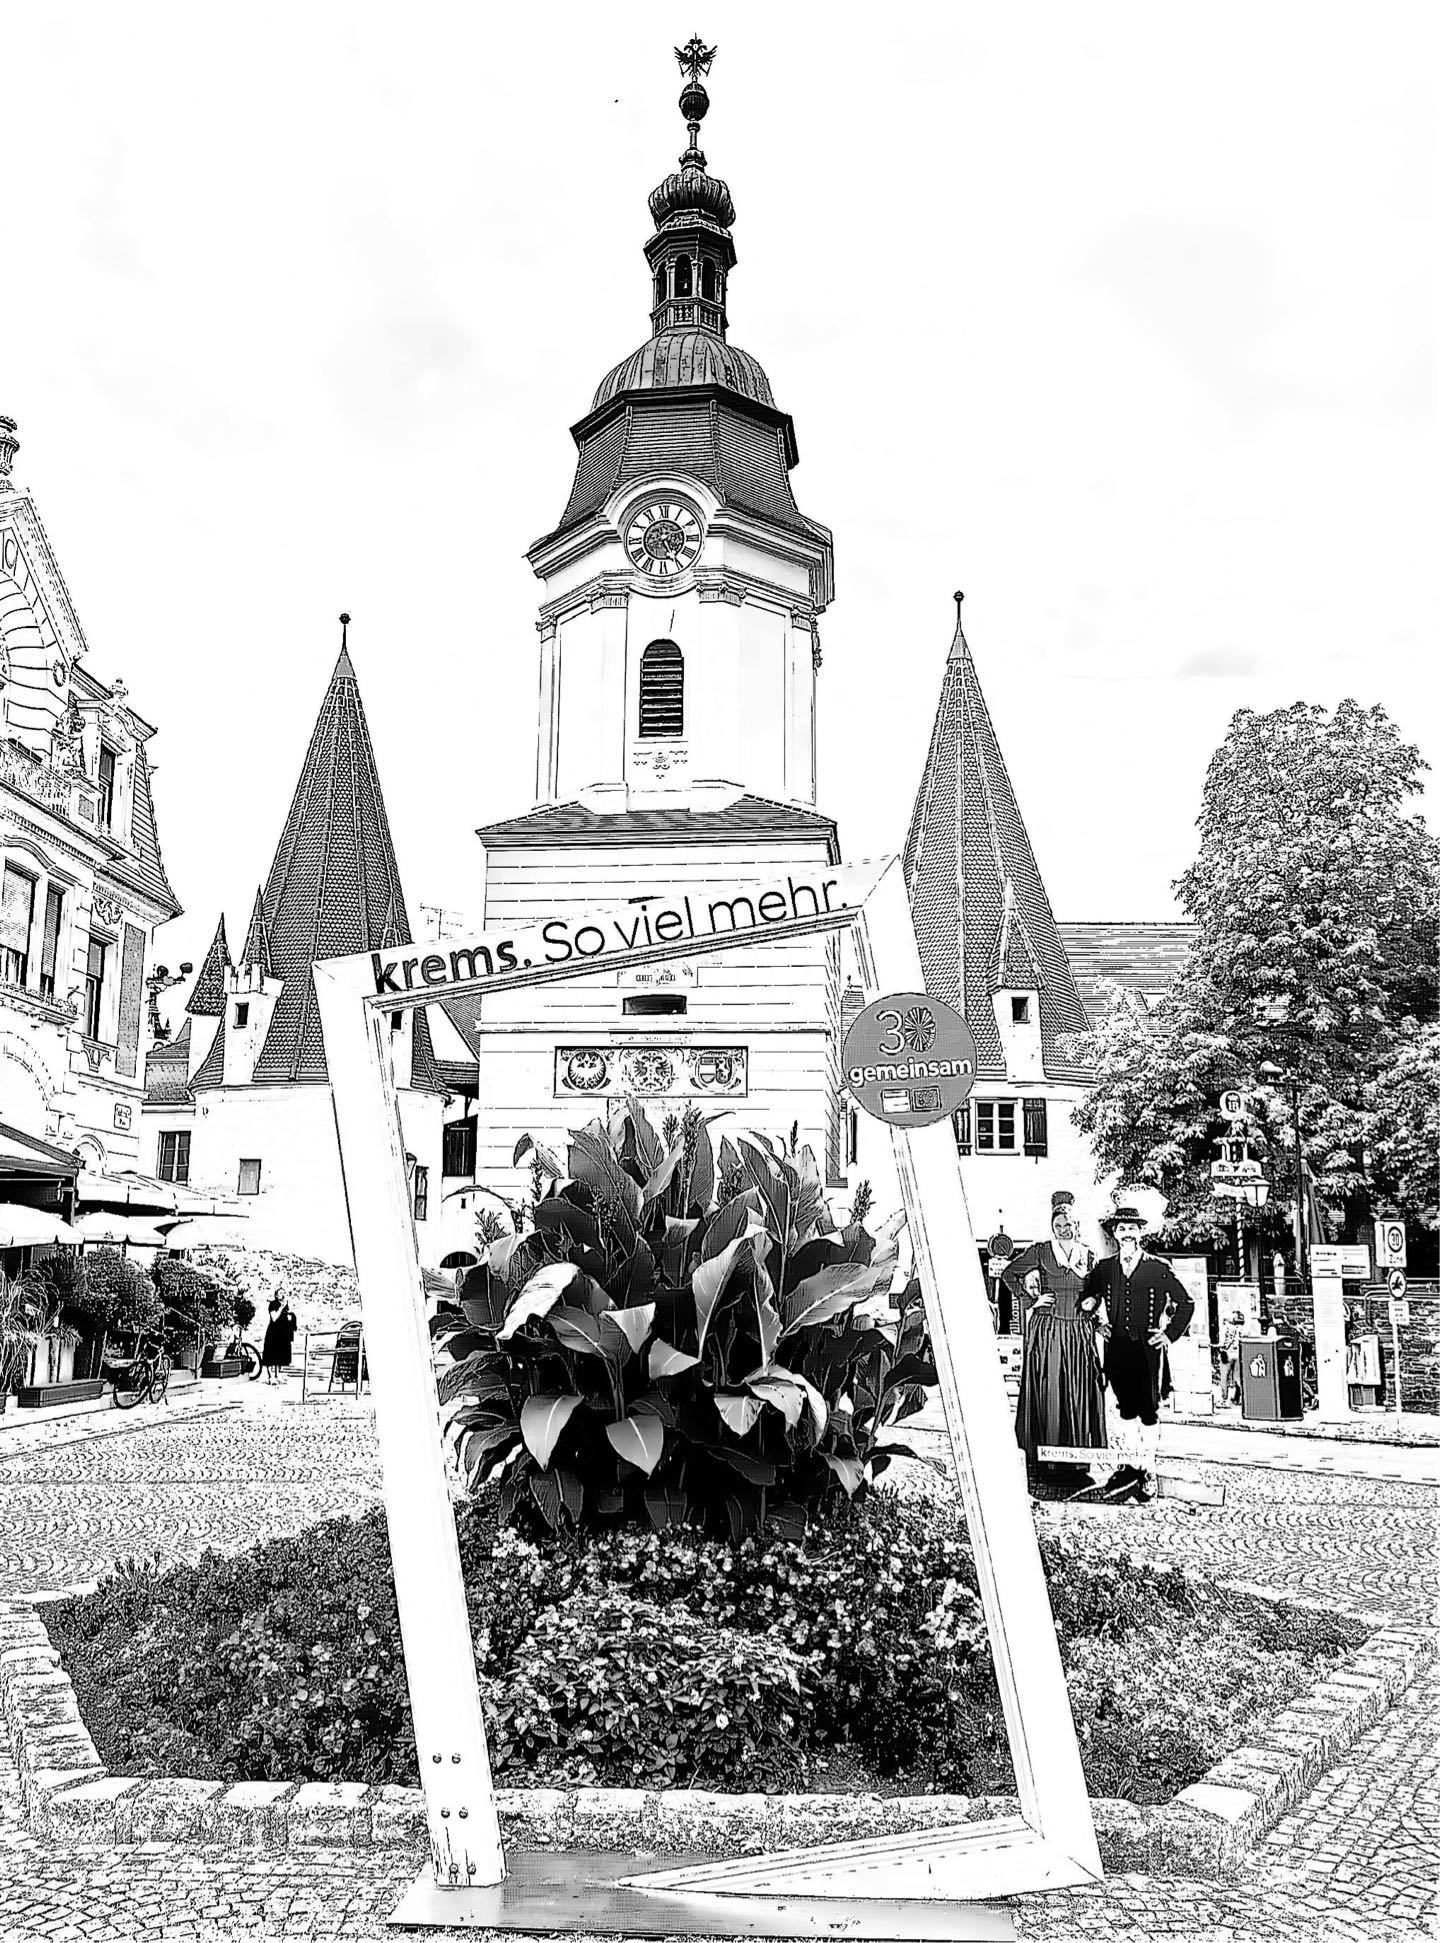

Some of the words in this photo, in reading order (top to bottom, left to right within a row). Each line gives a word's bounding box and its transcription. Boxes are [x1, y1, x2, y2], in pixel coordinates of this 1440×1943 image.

[370, 940, 532, 994] krems.
[542, 921, 605, 963] So
[613, 896, 695, 949] viel
[708, 876, 848, 934] mehr.
[849, 1057, 973, 1089] gemeinsam
[1009, 1294, 1021, 1336] illkom
